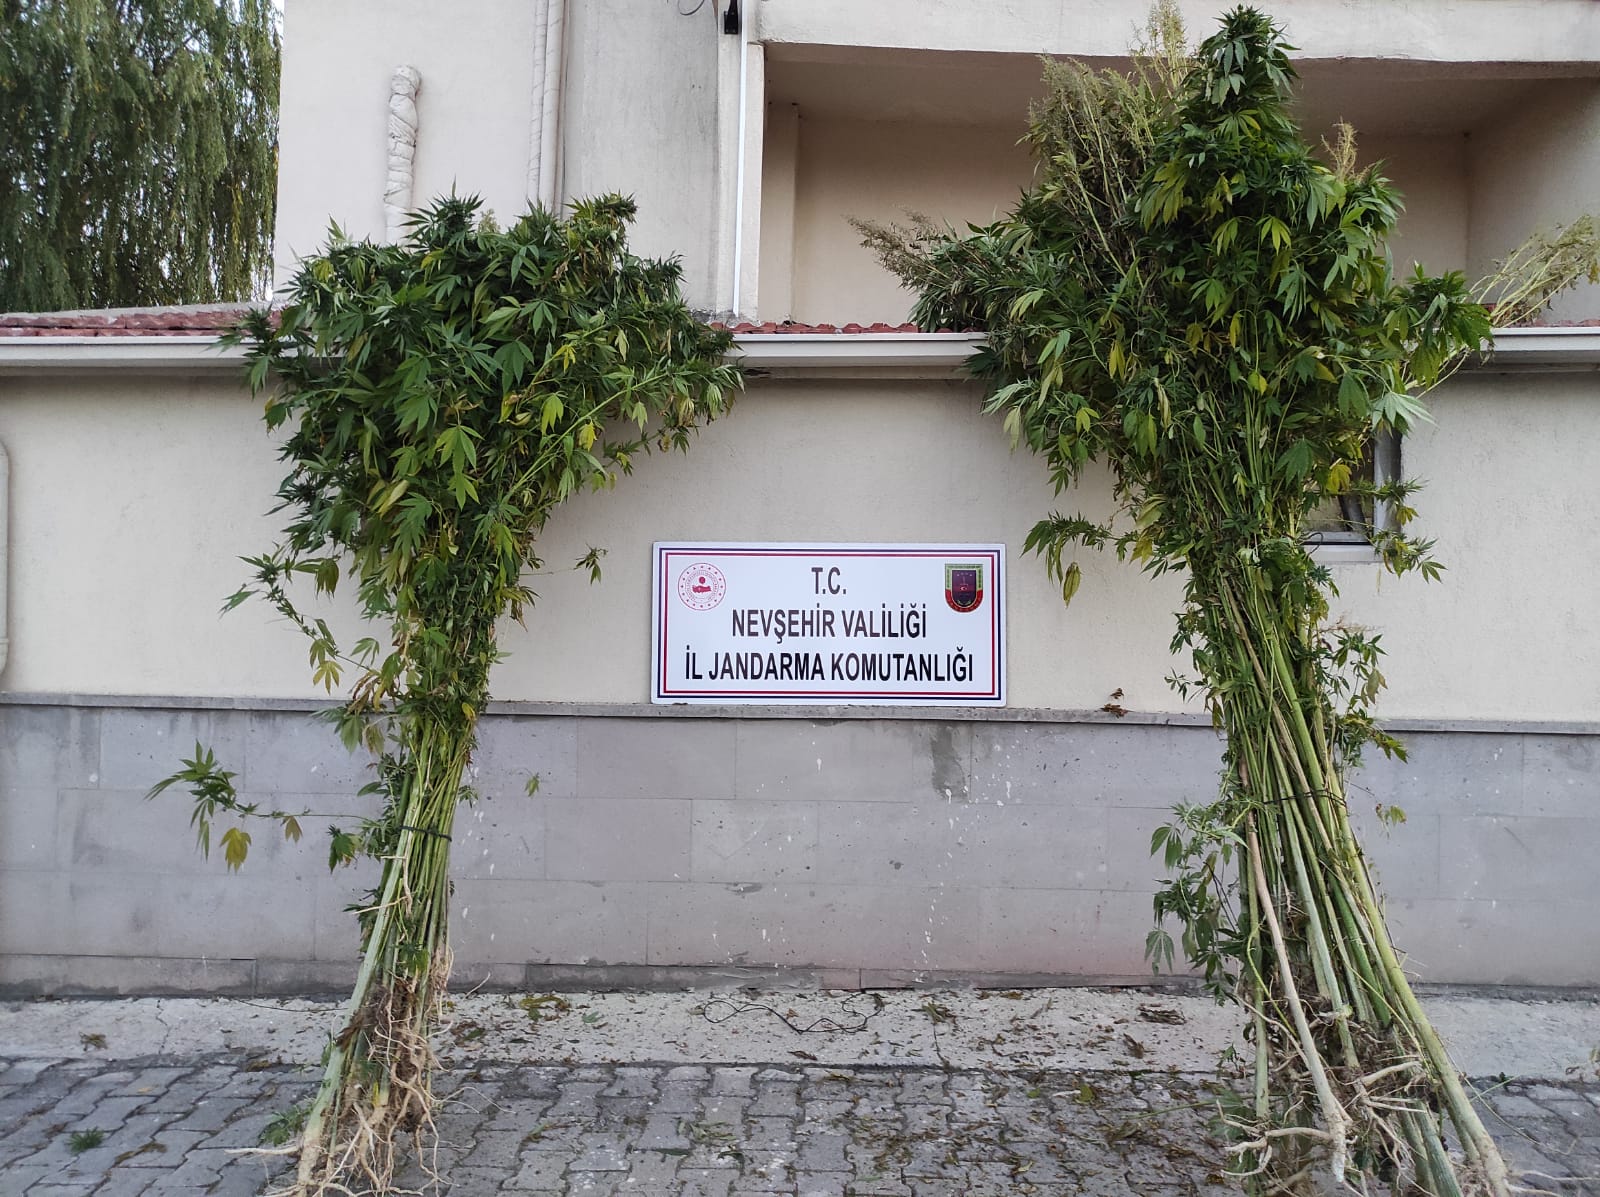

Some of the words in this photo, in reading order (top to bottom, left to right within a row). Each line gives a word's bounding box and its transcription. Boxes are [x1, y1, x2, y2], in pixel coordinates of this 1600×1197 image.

[811, 567, 847, 595] T.C.
[732, 603, 835, 645] NEVŞEHİR
[841, 603, 926, 638] VALİLİĞİ
[685, 645, 703, 680] İL
[708, 652, 826, 681] JANDARMA
[831, 646, 973, 682] KOMUTANLIĞI
